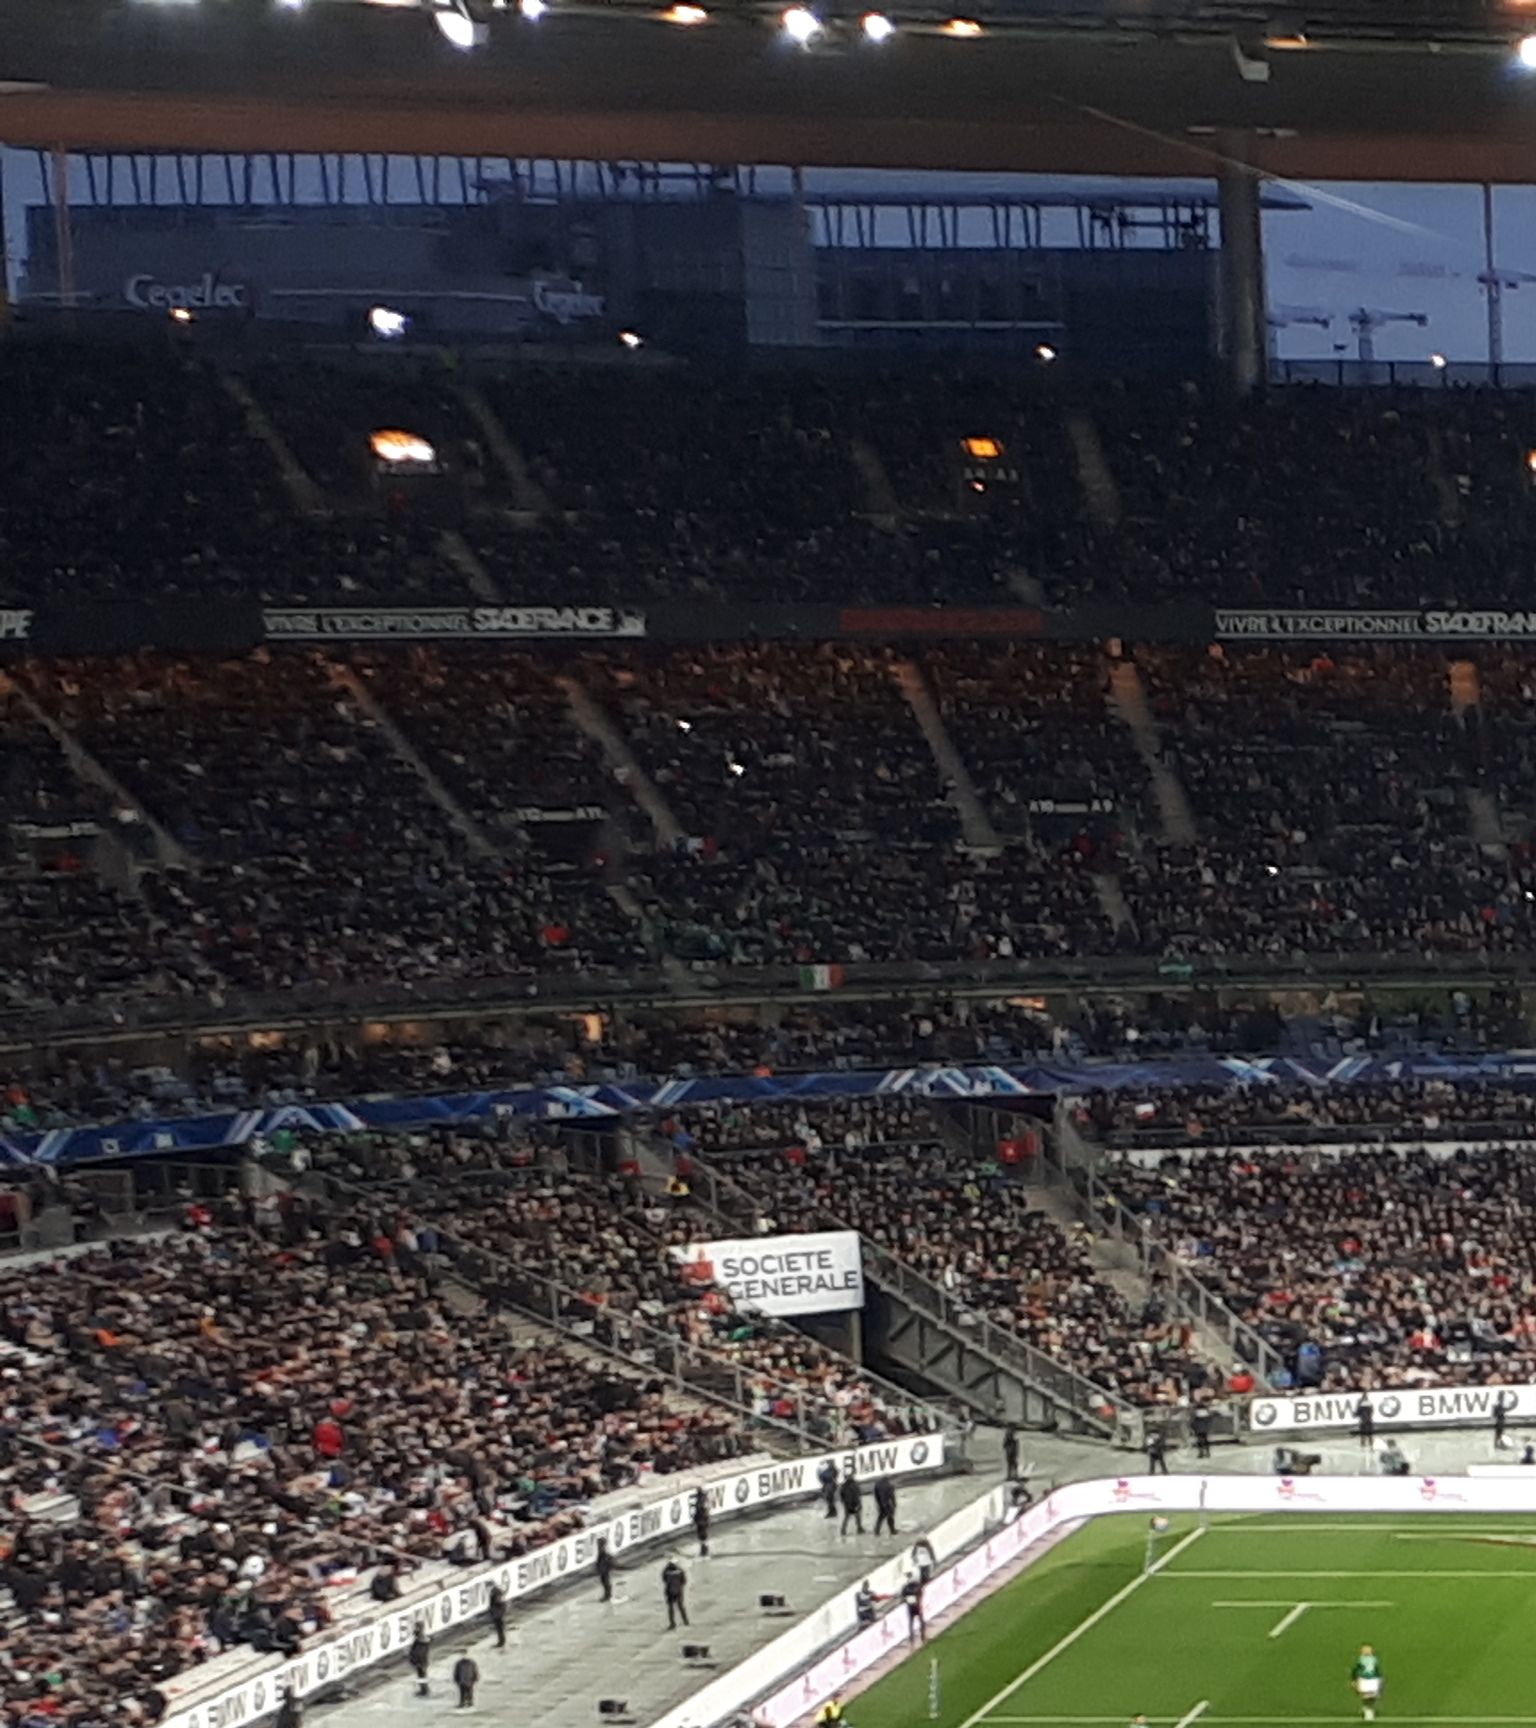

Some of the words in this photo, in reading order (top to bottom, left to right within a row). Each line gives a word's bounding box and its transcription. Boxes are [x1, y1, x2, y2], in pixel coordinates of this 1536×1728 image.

[722, 1250, 833, 1278] SOCIETE
[727, 1270, 860, 1301] GENERALE
[1417, 1392, 1490, 1417] BMW
[757, 1464, 805, 1499] BMW
[628, 1505, 663, 1540] BMW
